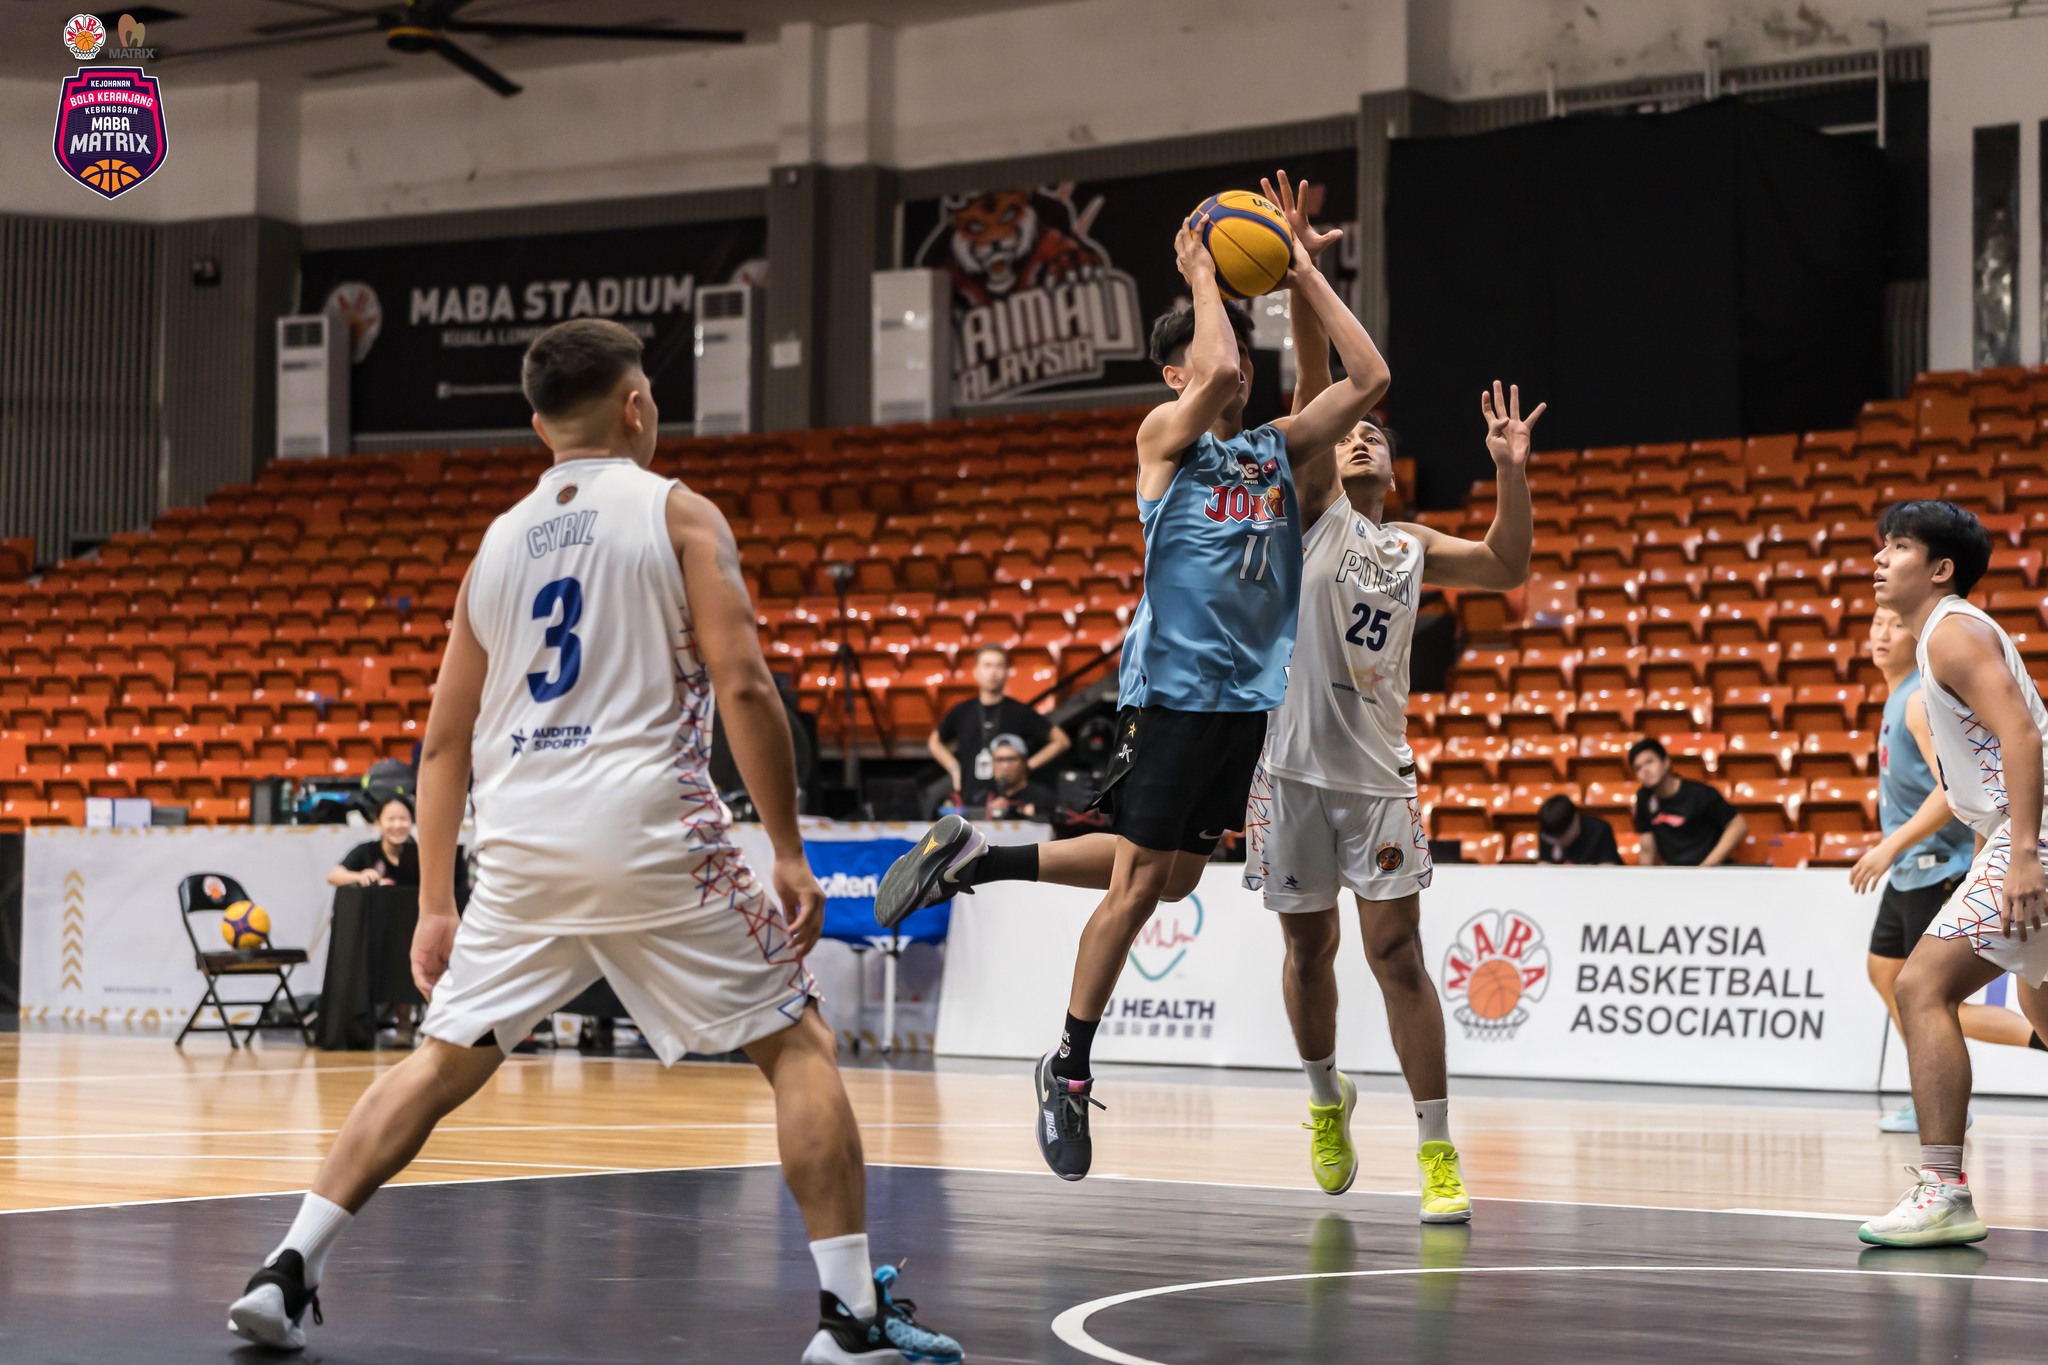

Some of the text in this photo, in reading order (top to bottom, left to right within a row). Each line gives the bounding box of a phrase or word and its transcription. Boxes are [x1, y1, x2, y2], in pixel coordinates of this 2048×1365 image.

[410, 285, 516, 327] MABA
[523, 274, 694, 319] STADIUM
[961, 337, 1095, 402] ALAYSIA
[527, 510, 598, 559] CYRIL
[1239, 534, 1270, 581] 11
[527, 577, 583, 703] 3
[1345, 602, 1392, 652] 25
[532, 725, 592, 739] AUDITRA
[533, 738, 588, 752] SPORTS
[815, 872, 879, 898] olten
[1447, 917, 1546, 991] MABA
[1581, 924, 1766, 956] MALAYSIA
[1576, 964, 1824, 998] BASKETBALL
[1122, 999, 1215, 1019] HEALTH
[1570, 1004, 1824, 1040] ASSOCIATION
